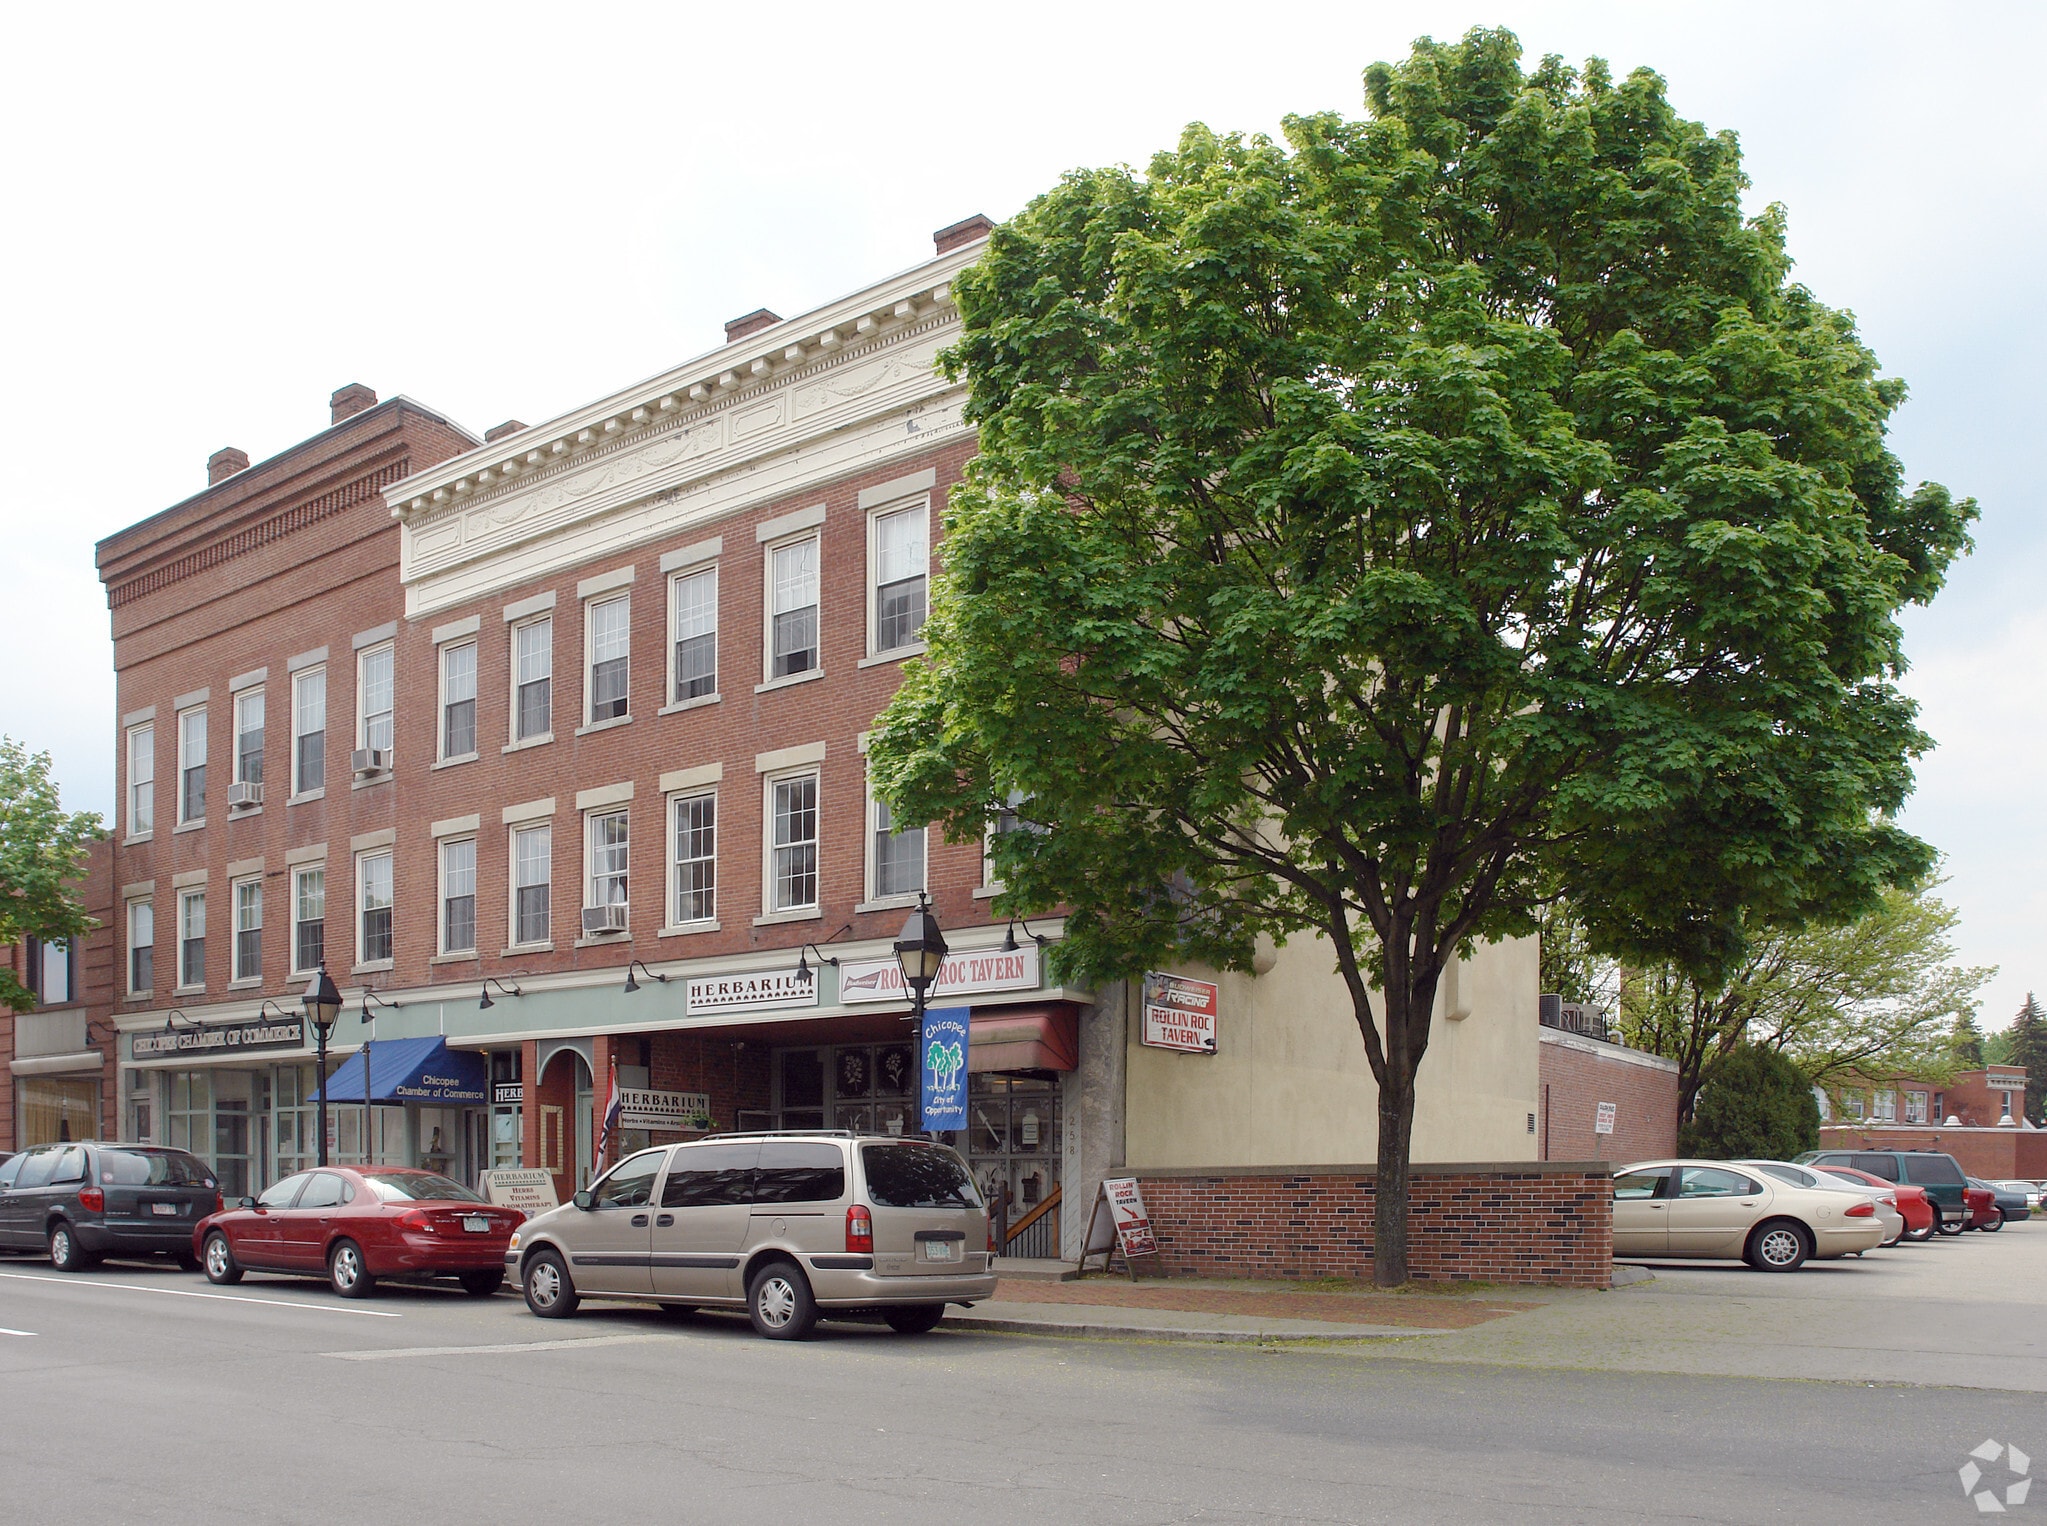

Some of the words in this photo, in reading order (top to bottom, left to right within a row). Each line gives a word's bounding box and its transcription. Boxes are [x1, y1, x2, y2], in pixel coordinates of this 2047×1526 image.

[969, 955, 1025, 982] TAVERN
[691, 975, 813, 998] HERBARIUM
[1169, 982, 1211, 995] BUDWEISER
[1166, 989, 1210, 1008] RACING
[1151, 1008, 1188, 1027] ROLLIN
[1191, 1015, 1210, 1030] ROC
[925, 1020, 967, 1038] Chicopee
[1161, 1027, 1200, 1045] TAVERN
[133, 1036, 177, 1052] CHICOPEE
[178, 1031, 227, 1049] CHAMBER
[226, 1030, 241, 1045] OF
[241, 1025, 301, 1044] COMMERCE
[422, 1075, 460, 1087] Chicopee
[396, 1086, 431, 1097] Chamber
[433, 1088, 441, 1097] of
[443, 1088, 485, 1099] Commerce
[933, 1096, 945, 1106] City
[946, 1094, 955, 1104] of
[622, 1092, 705, 1109] HERBARIUM
[925, 1105, 963, 1117] Opportunity
[493, 1172, 545, 1181] HERBARIUM
[1115, 1190, 1134, 1198] ROCK
[1116, 1198, 1138, 1206] TAVERN
